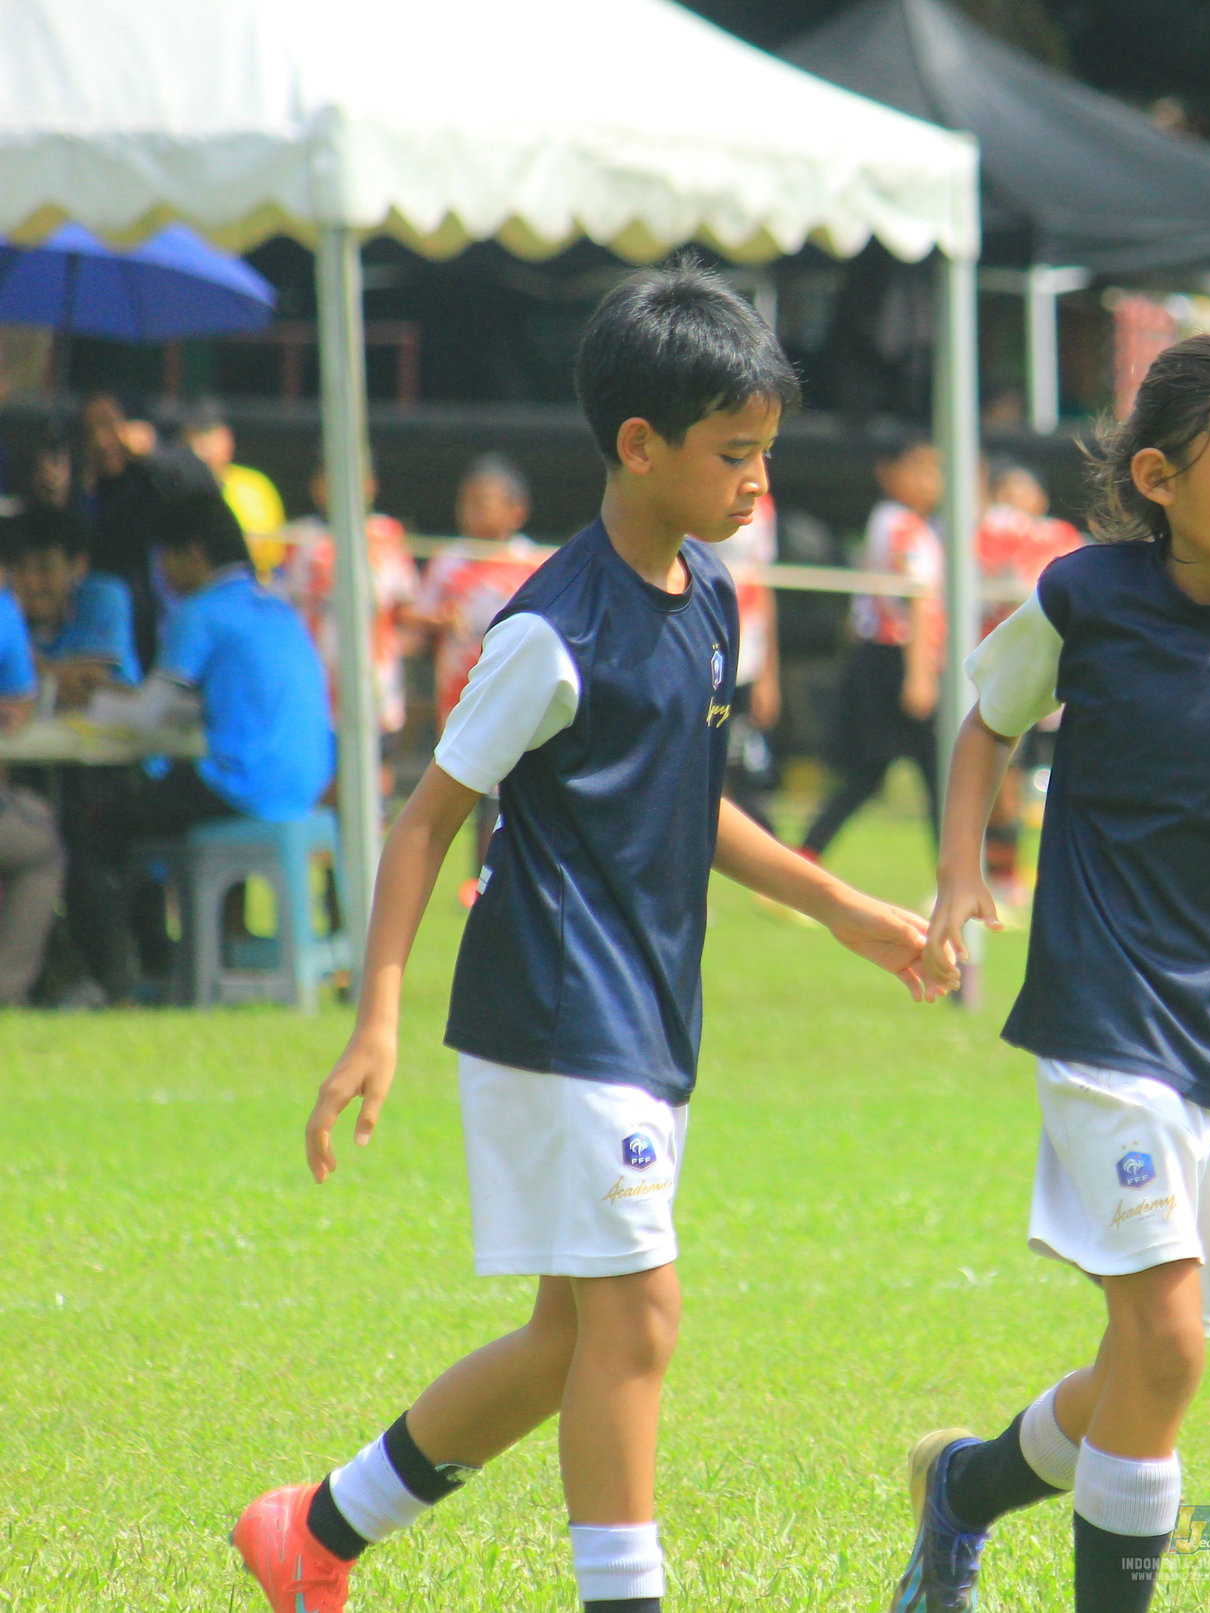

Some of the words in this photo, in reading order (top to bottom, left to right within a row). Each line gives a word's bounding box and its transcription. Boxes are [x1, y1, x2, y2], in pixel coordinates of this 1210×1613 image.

[631, 1157, 651, 1165] FFF
[1127, 1175, 1149, 1185] FFF
[1108, 1194, 1178, 1231] Academy
